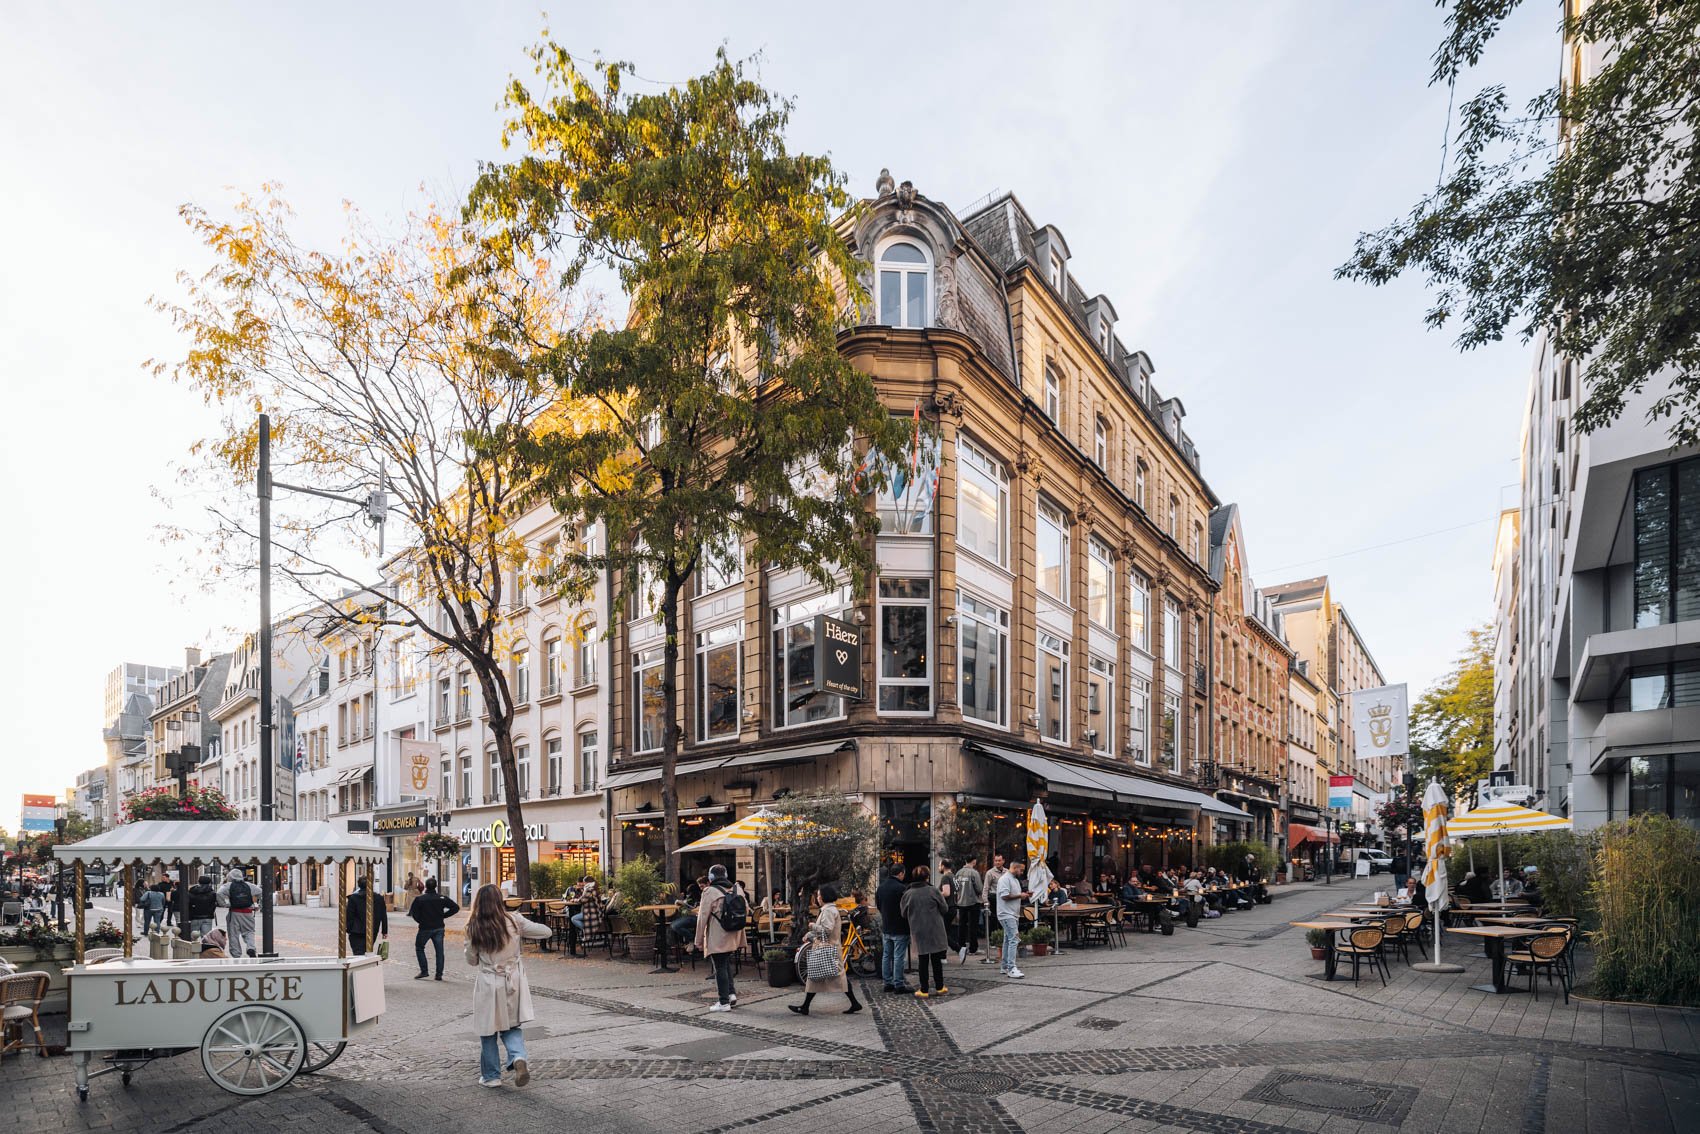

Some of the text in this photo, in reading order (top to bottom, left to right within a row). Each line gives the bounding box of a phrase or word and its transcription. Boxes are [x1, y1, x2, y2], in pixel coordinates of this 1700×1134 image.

[825, 621, 857, 645] Häerz
[826, 680, 839, 689] Heart
[839, 683, 844, 691] of
[377, 816, 417, 830] BOUNCEWEAR
[114, 972, 304, 1006] LADURÉE
